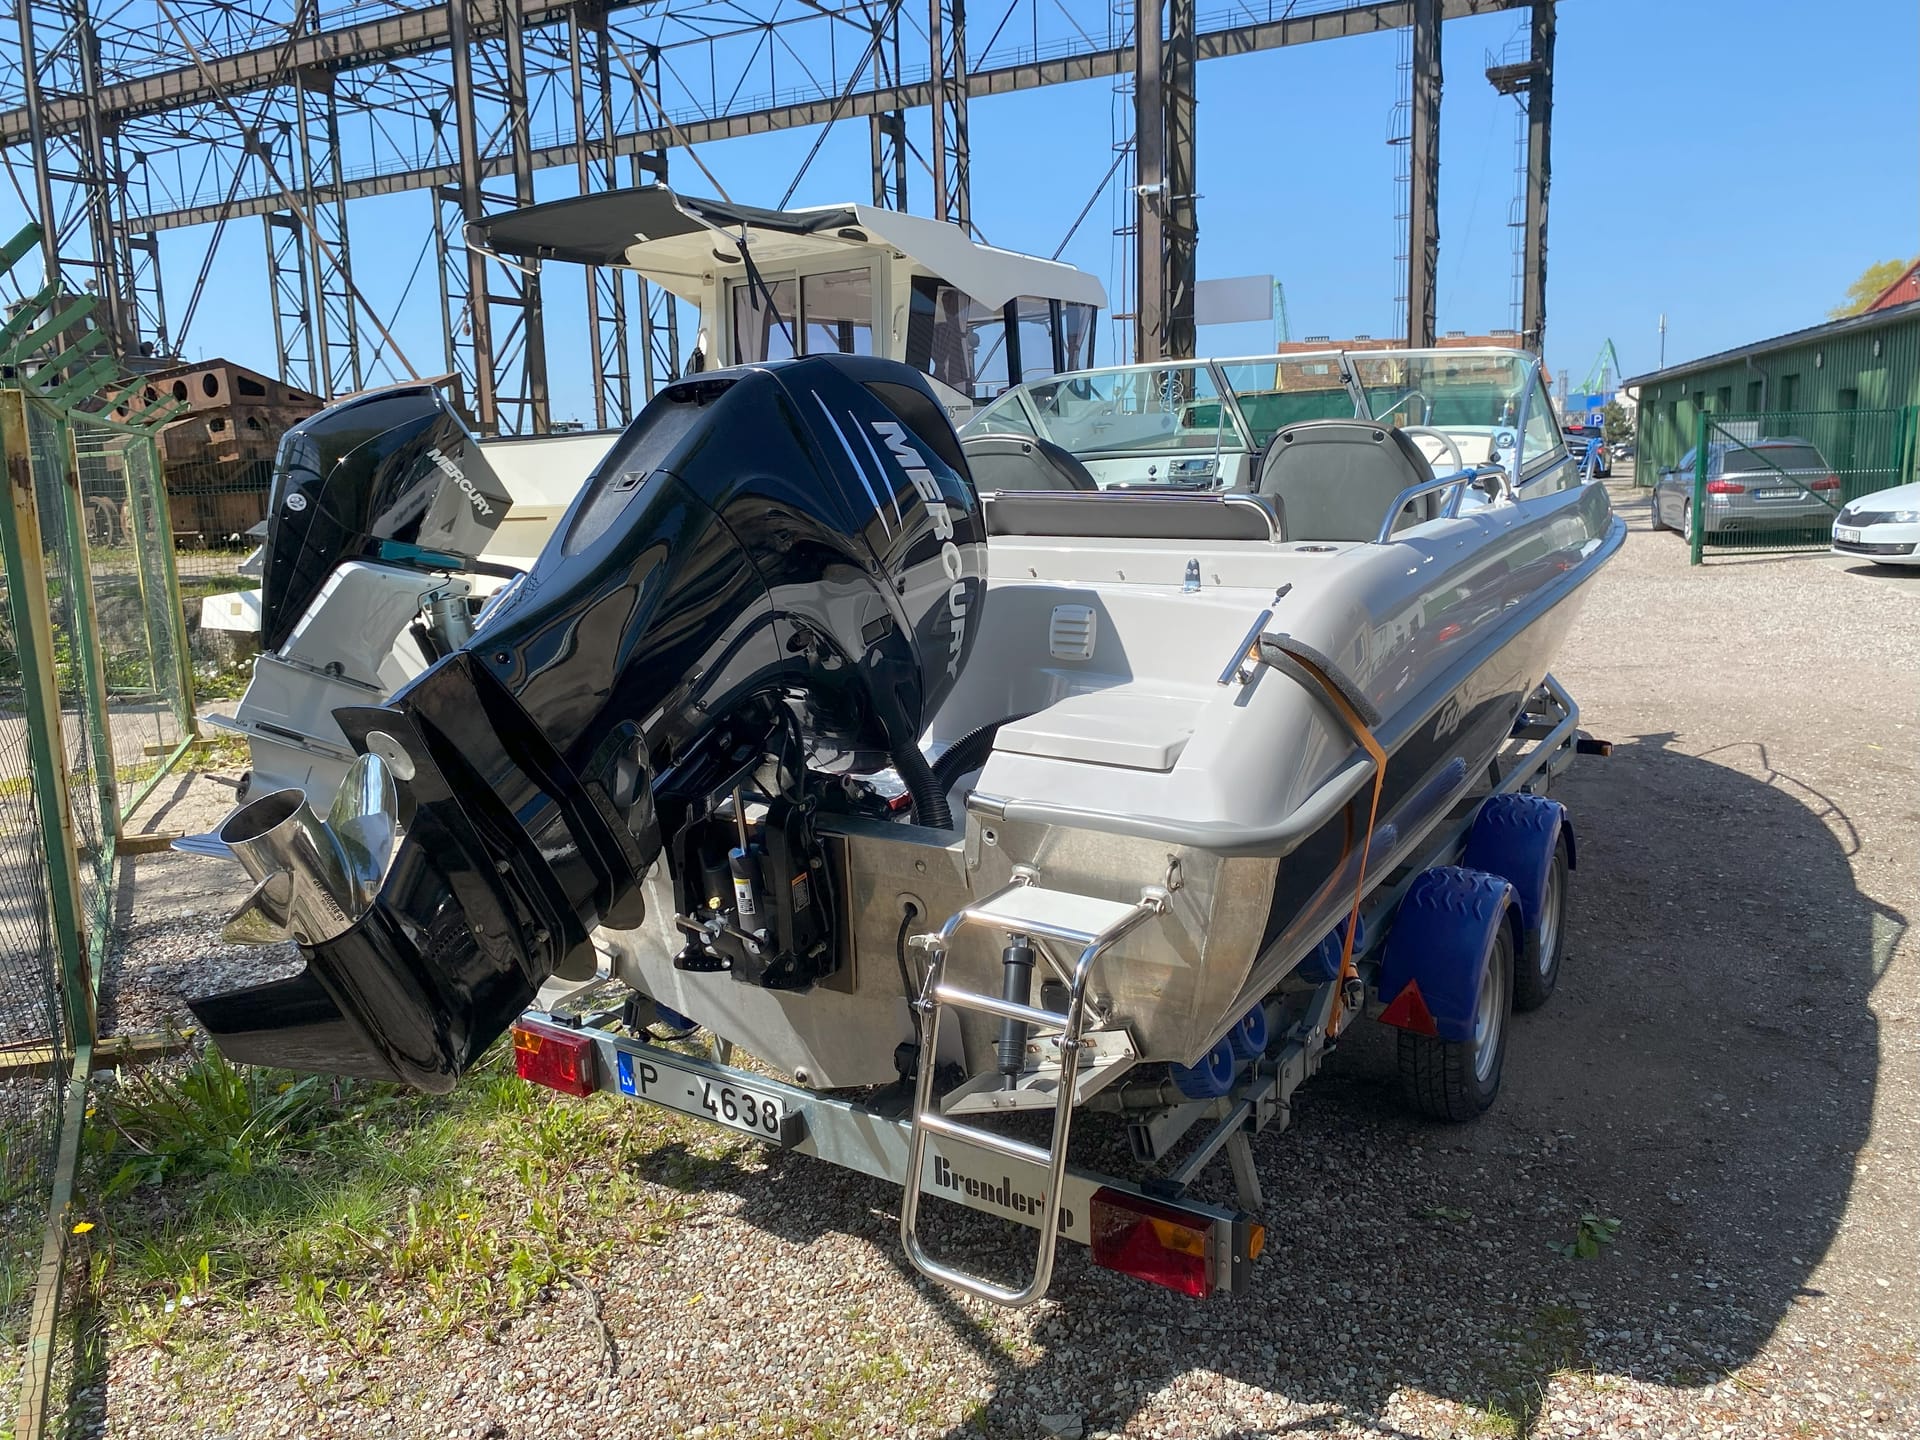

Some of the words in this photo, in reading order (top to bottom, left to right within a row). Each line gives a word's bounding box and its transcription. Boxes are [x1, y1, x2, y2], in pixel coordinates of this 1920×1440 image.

[1593, 415, 1602, 427] P
[426, 448, 494, 516] MERCURY
[871, 421, 967, 680] MERCURY
[622, 1076, 633, 1087] LV
[639, 1062, 658, 1094] P
[934, 1155, 1074, 1233] Brenderp
